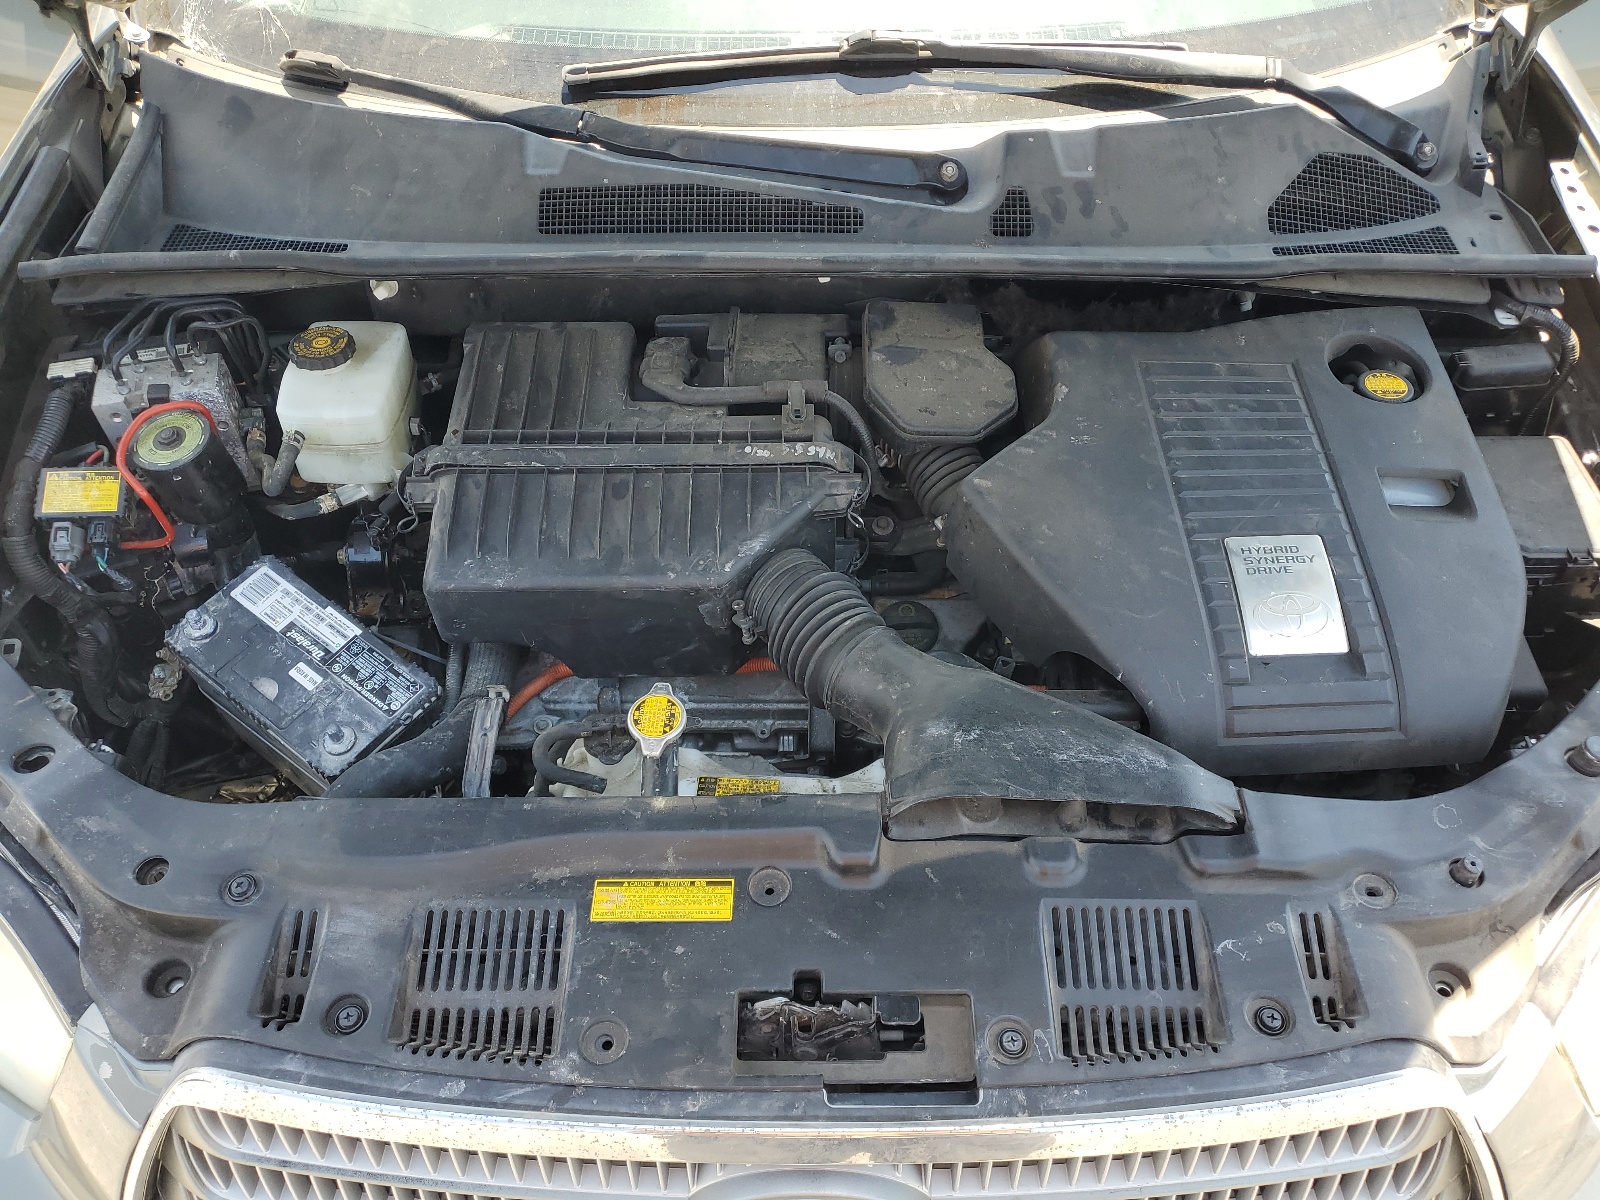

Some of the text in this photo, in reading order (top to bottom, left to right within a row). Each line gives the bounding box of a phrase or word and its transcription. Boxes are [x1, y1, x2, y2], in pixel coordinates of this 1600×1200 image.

[1240, 545, 1300, 555] HYBRID
[1243, 555, 1316, 566] SYNERGY
[1246, 566, 1294, 576] DRIVE
[285, 629, 326, 661] Duralast
[340, 673, 386, 709] DANGER/POISON
